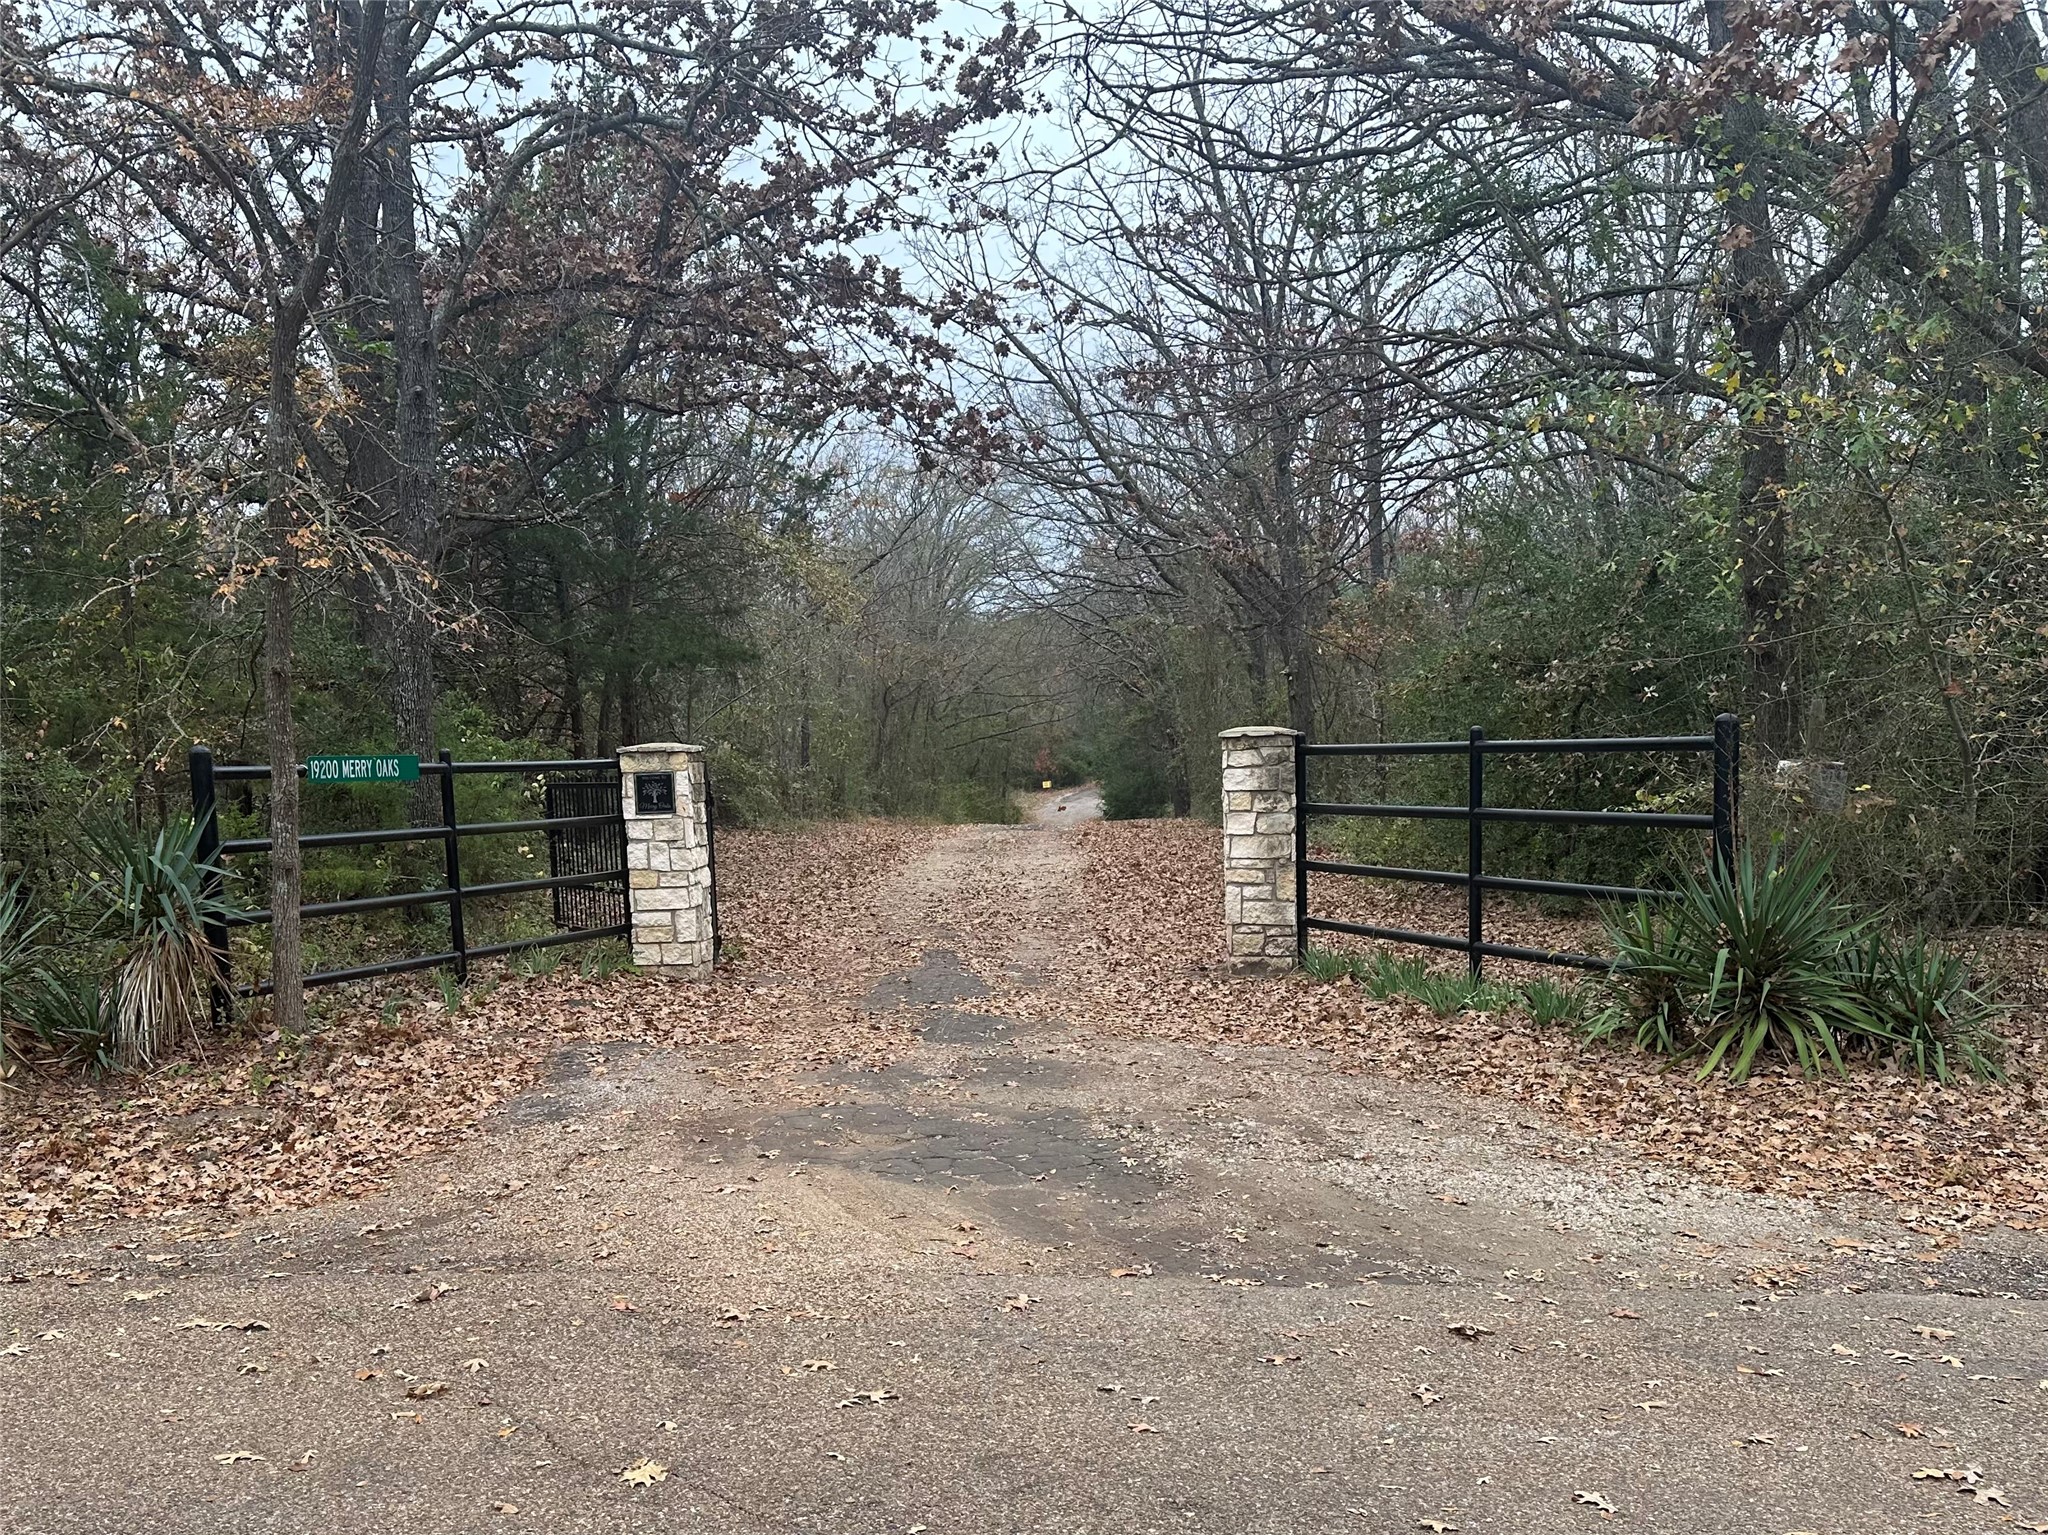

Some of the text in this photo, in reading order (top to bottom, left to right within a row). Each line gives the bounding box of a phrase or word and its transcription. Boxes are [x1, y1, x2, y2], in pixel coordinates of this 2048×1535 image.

[310, 758, 399, 779] 19200 MERRY OAKS
